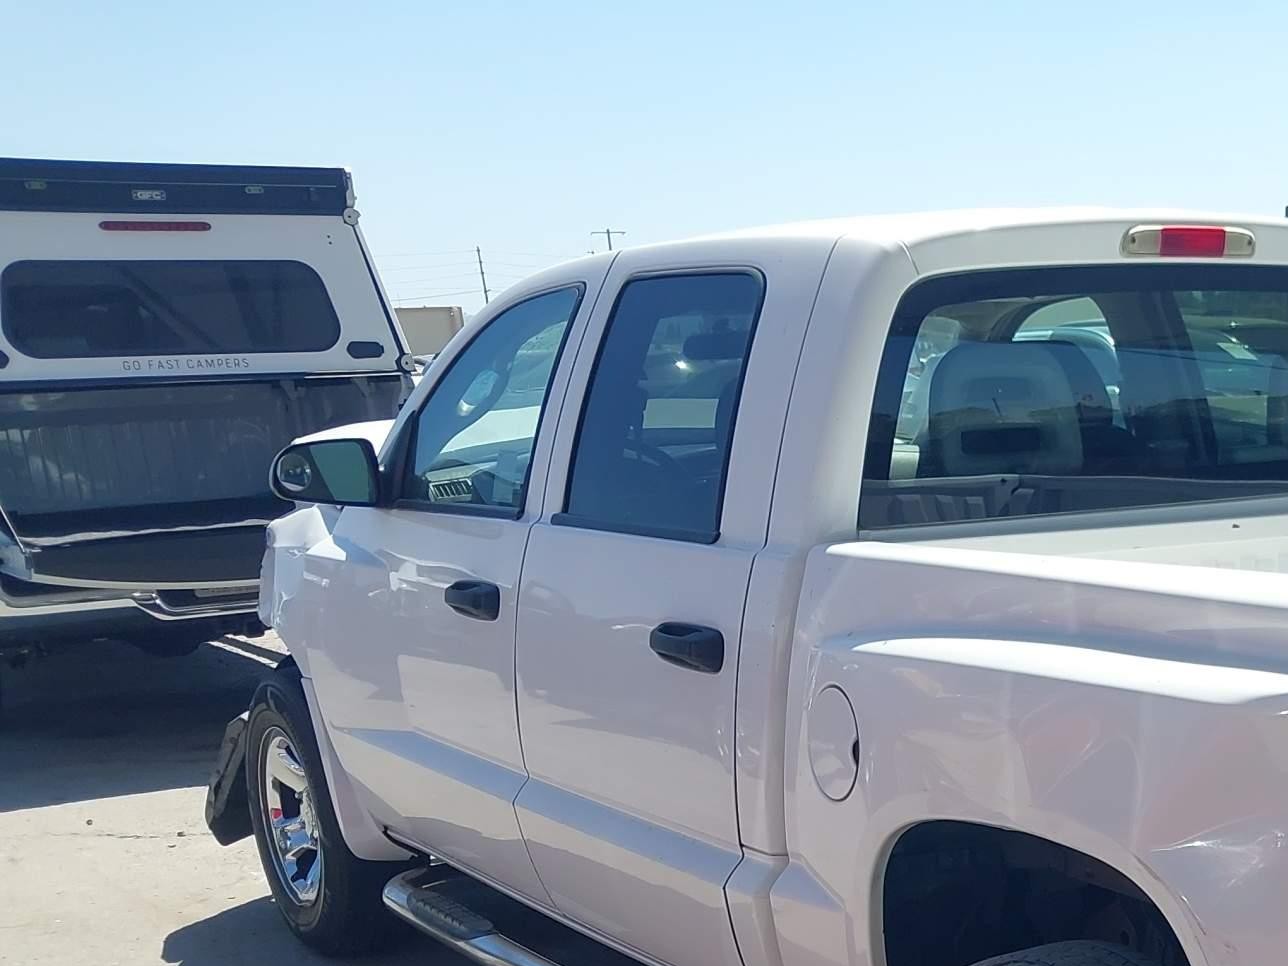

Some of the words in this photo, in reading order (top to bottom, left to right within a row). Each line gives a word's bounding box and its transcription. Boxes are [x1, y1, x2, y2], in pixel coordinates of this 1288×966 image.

[136, 190, 161, 200] GFC
[122, 360, 141, 371] GO
[147, 359, 180, 370] FAST
[186, 358, 250, 369] CAMPERS
